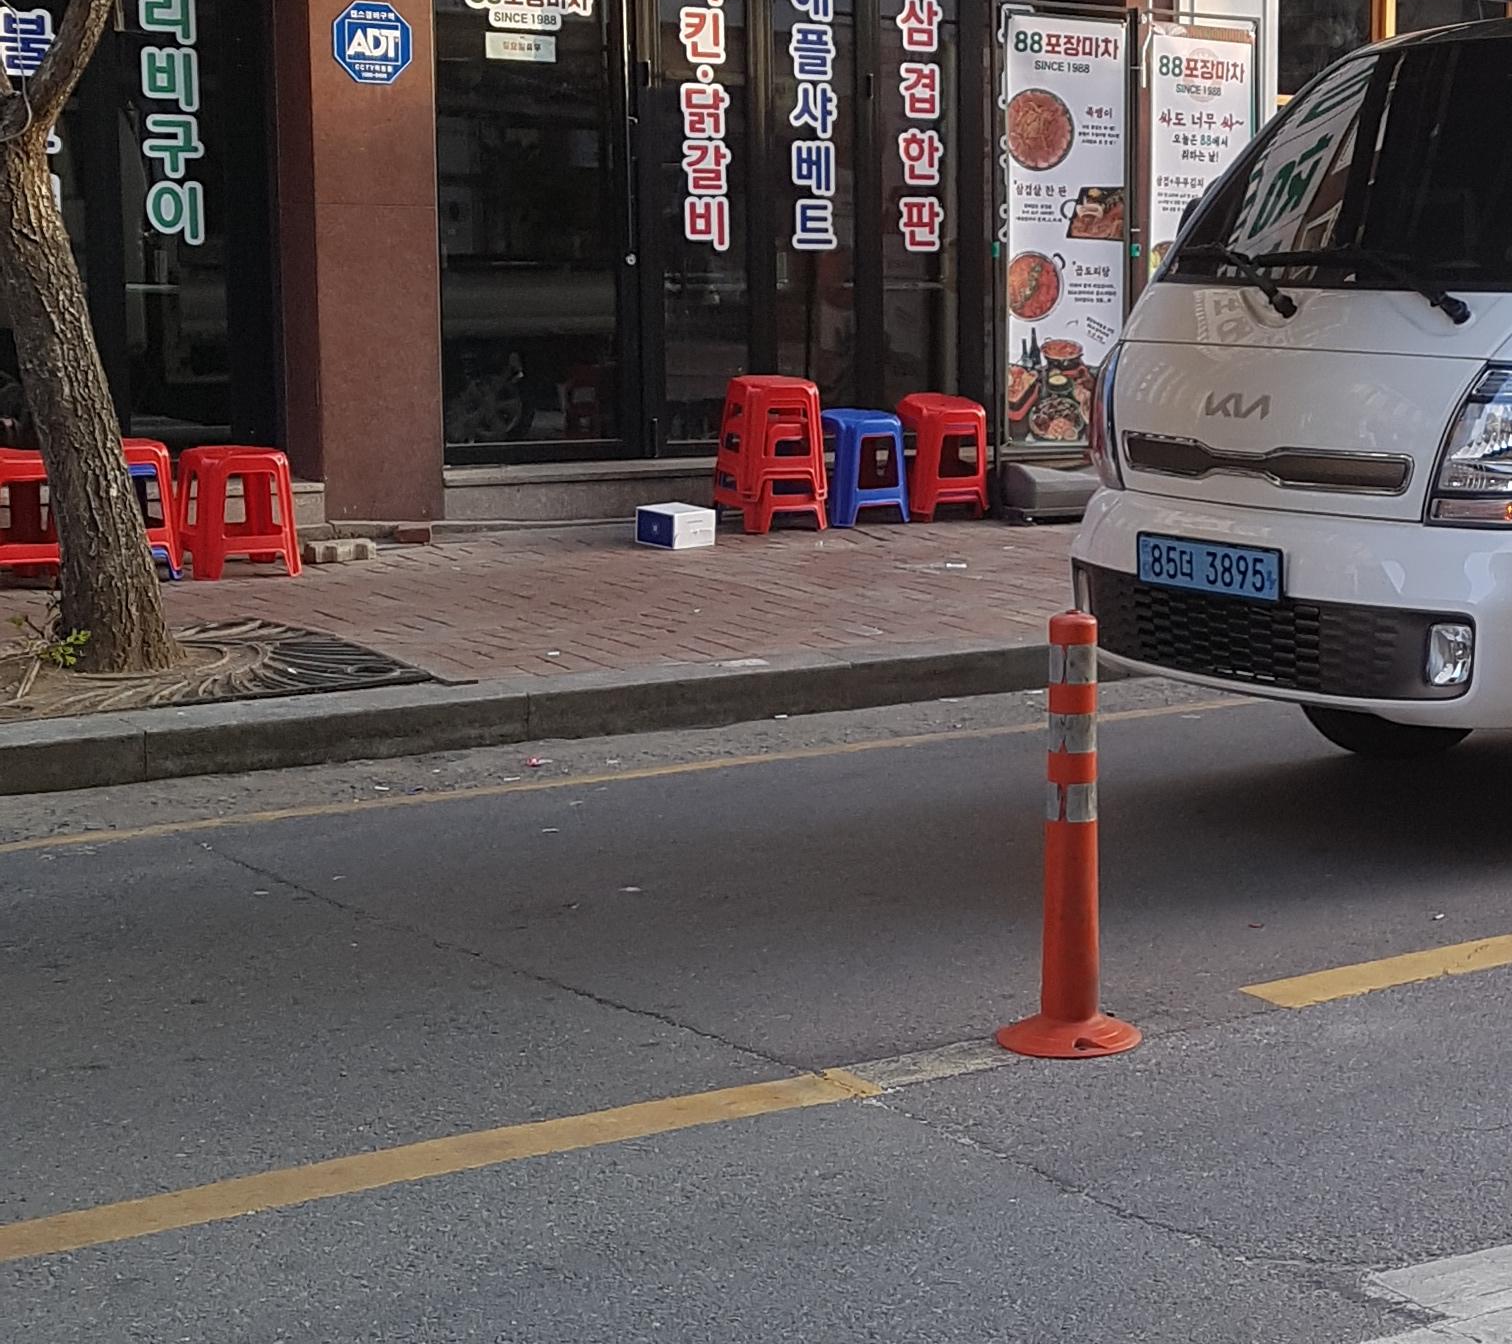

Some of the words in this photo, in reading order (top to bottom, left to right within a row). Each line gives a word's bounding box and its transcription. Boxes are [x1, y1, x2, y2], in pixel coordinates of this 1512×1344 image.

[494, 11, 528, 24] SINCE
[532, 13, 557, 25] 1988
[346, 27, 400, 58] ADT
[1014, 30, 1119, 60] 88포장마차
[1034, 59, 1065, 72] SINCE
[1067, 62, 1091, 74] 1988
[1158, 54, 1245, 84] 88포장마차
[1175, 83, 1201, 95] SINCE
[1203, 85, 1222, 97] 1988
[1158, 108, 1187, 127] 싸도
[1191, 111, 1217, 129] 너무
[1172, 133, 1197, 146] 오늘은
[1016, 184, 1041, 197] 삼겹살
[1045, 185, 1055, 197] 한
[1204, 391, 1271, 420] KIA
[1151, 543, 1194, 582] 85더
[1205, 550, 1266, 593] 3895
